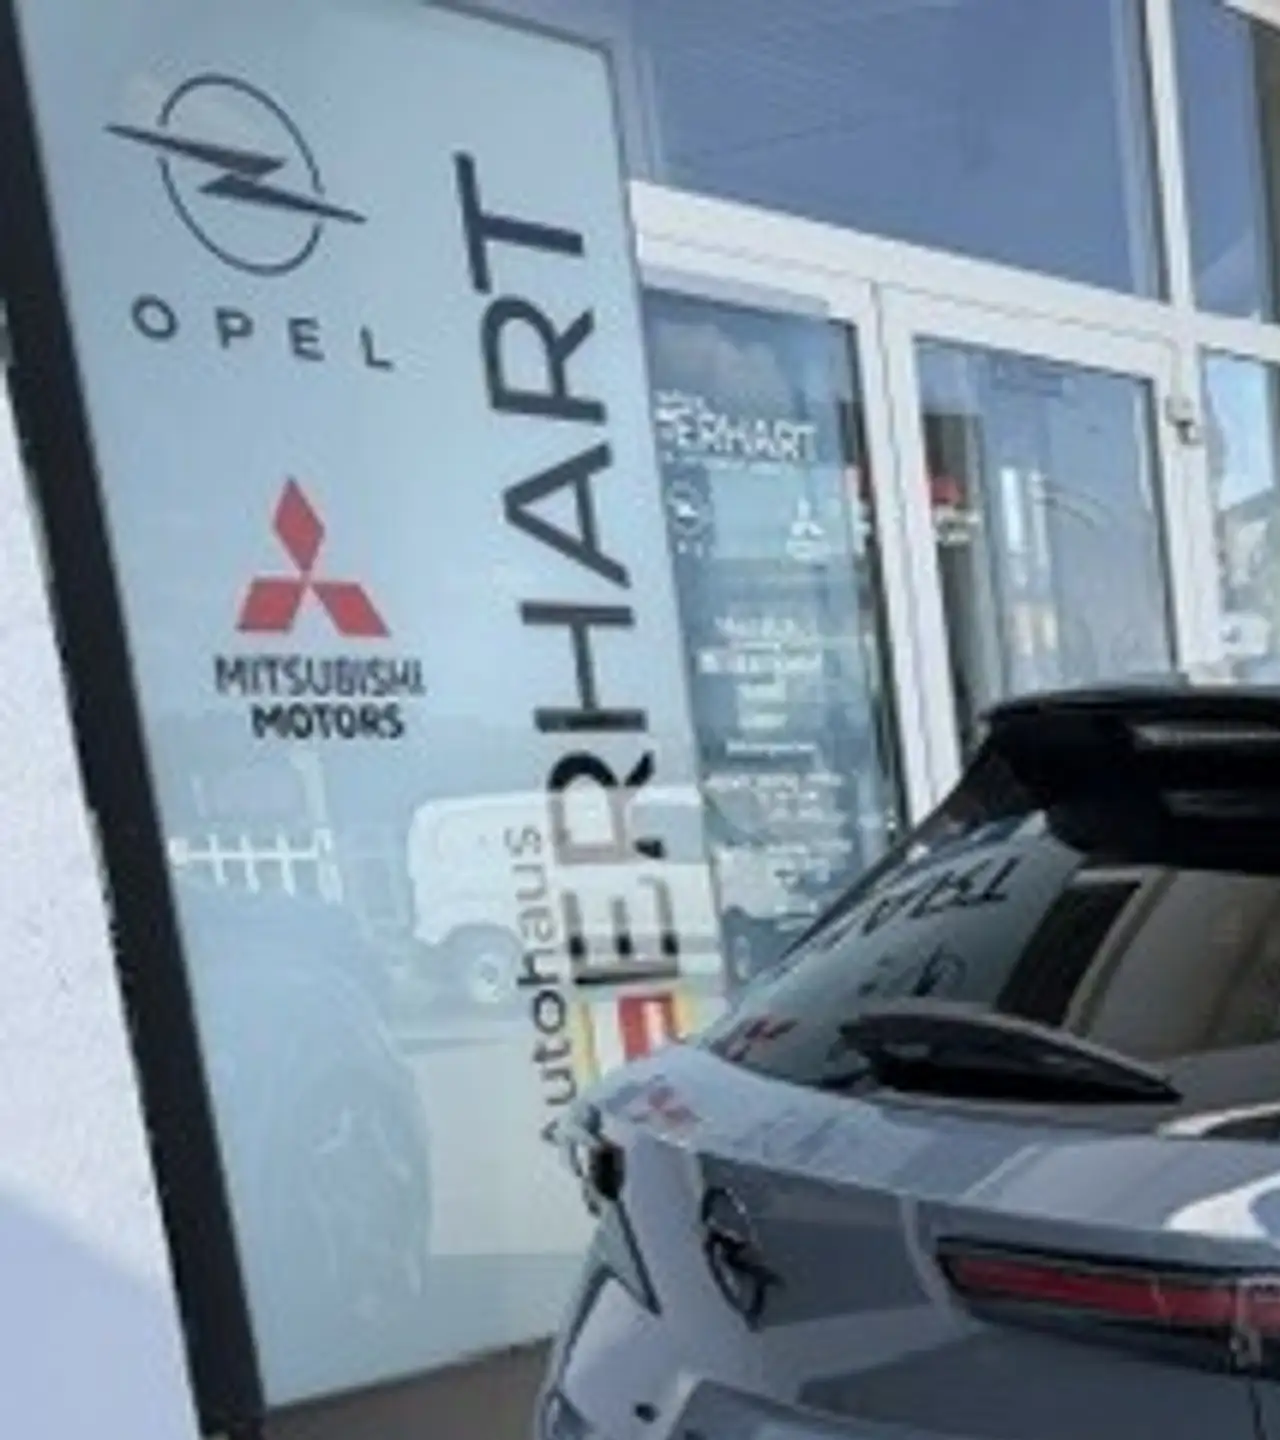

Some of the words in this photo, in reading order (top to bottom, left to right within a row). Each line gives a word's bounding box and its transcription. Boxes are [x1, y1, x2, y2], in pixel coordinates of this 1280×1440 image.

[131, 295, 394, 371] OPEL
[455, 151, 680, 986] ERHART
[214, 655, 426, 697] MITSUBISHI
[251, 703, 405, 739] MOTORS
